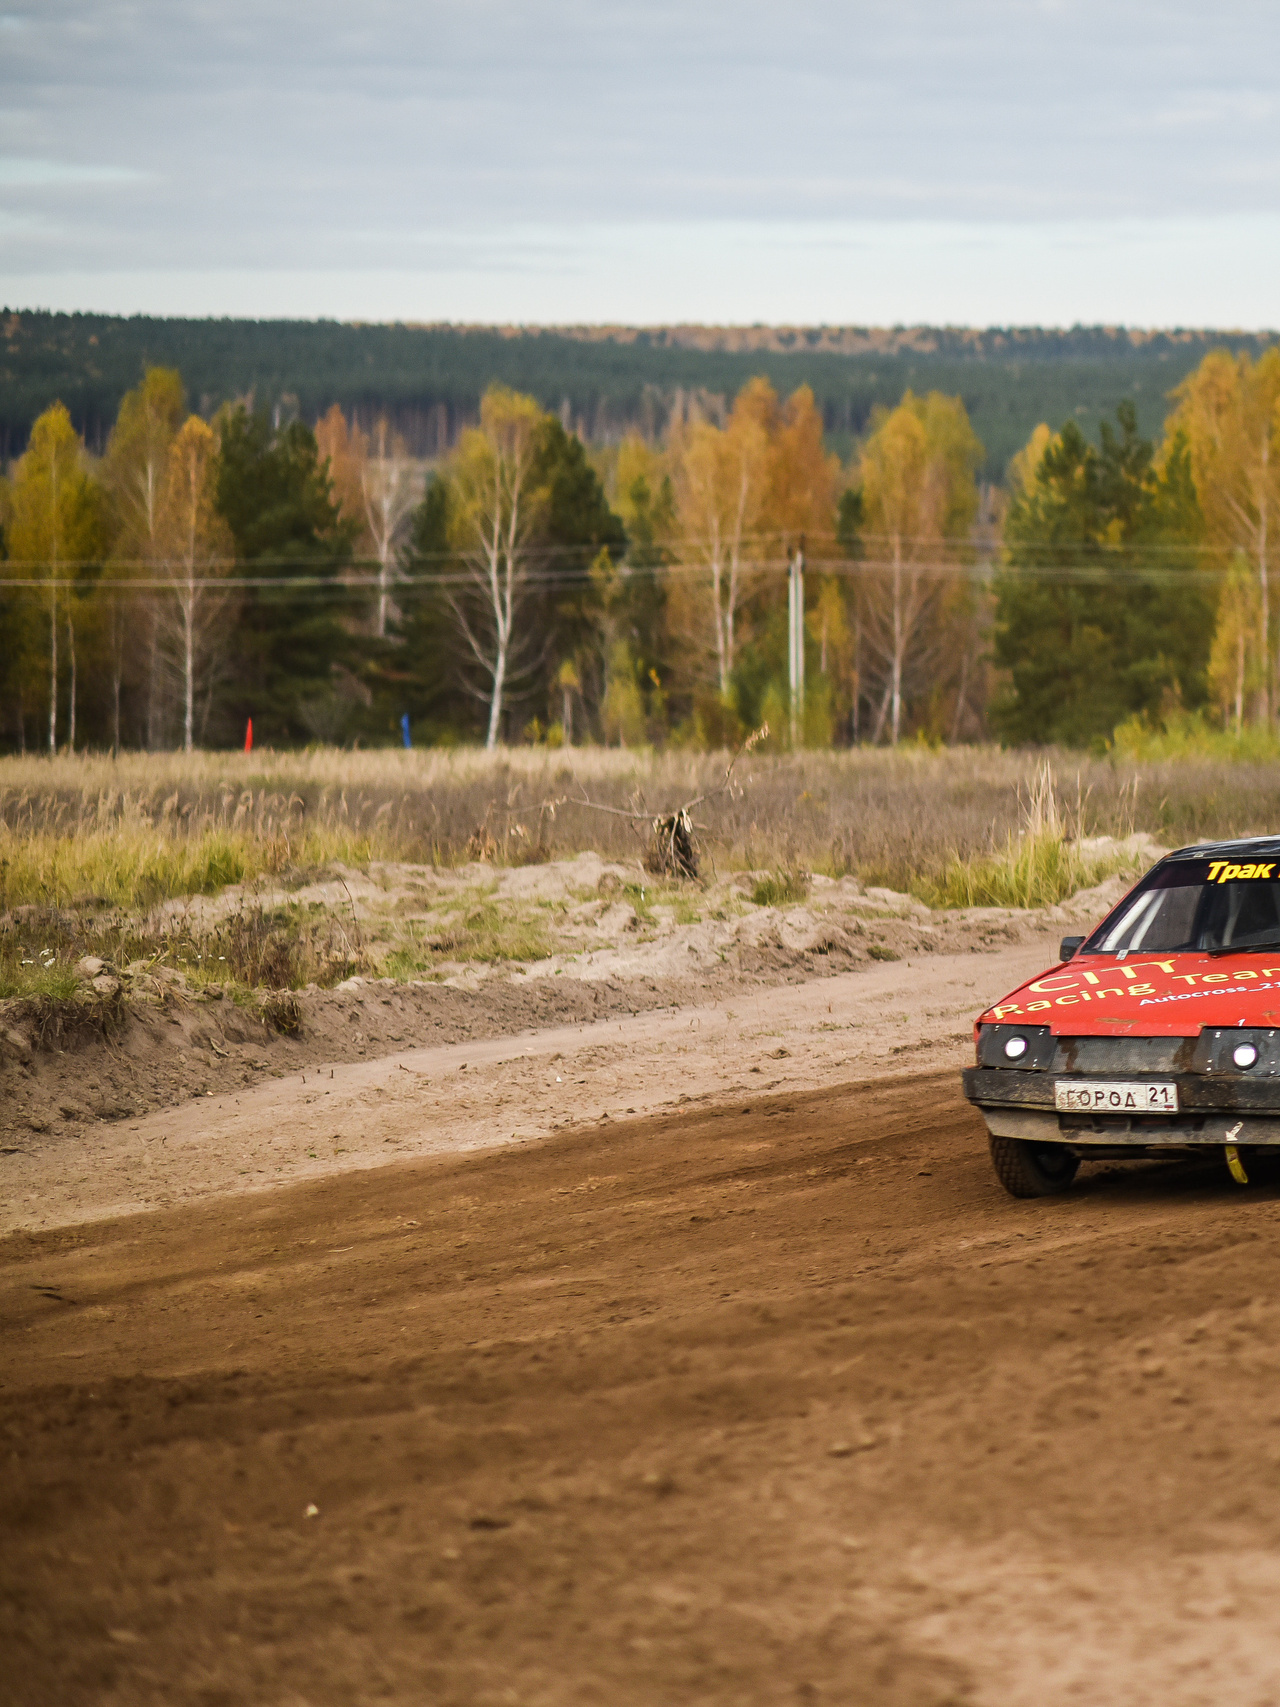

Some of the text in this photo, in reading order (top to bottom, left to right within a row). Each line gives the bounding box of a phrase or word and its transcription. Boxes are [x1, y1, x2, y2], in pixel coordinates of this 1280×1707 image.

[1206, 861, 1276, 884] Трак
[1028, 959, 1177, 993] CITY
[992, 982, 1157, 1019] Racing
[1148, 1086, 1168, 1103] 21
